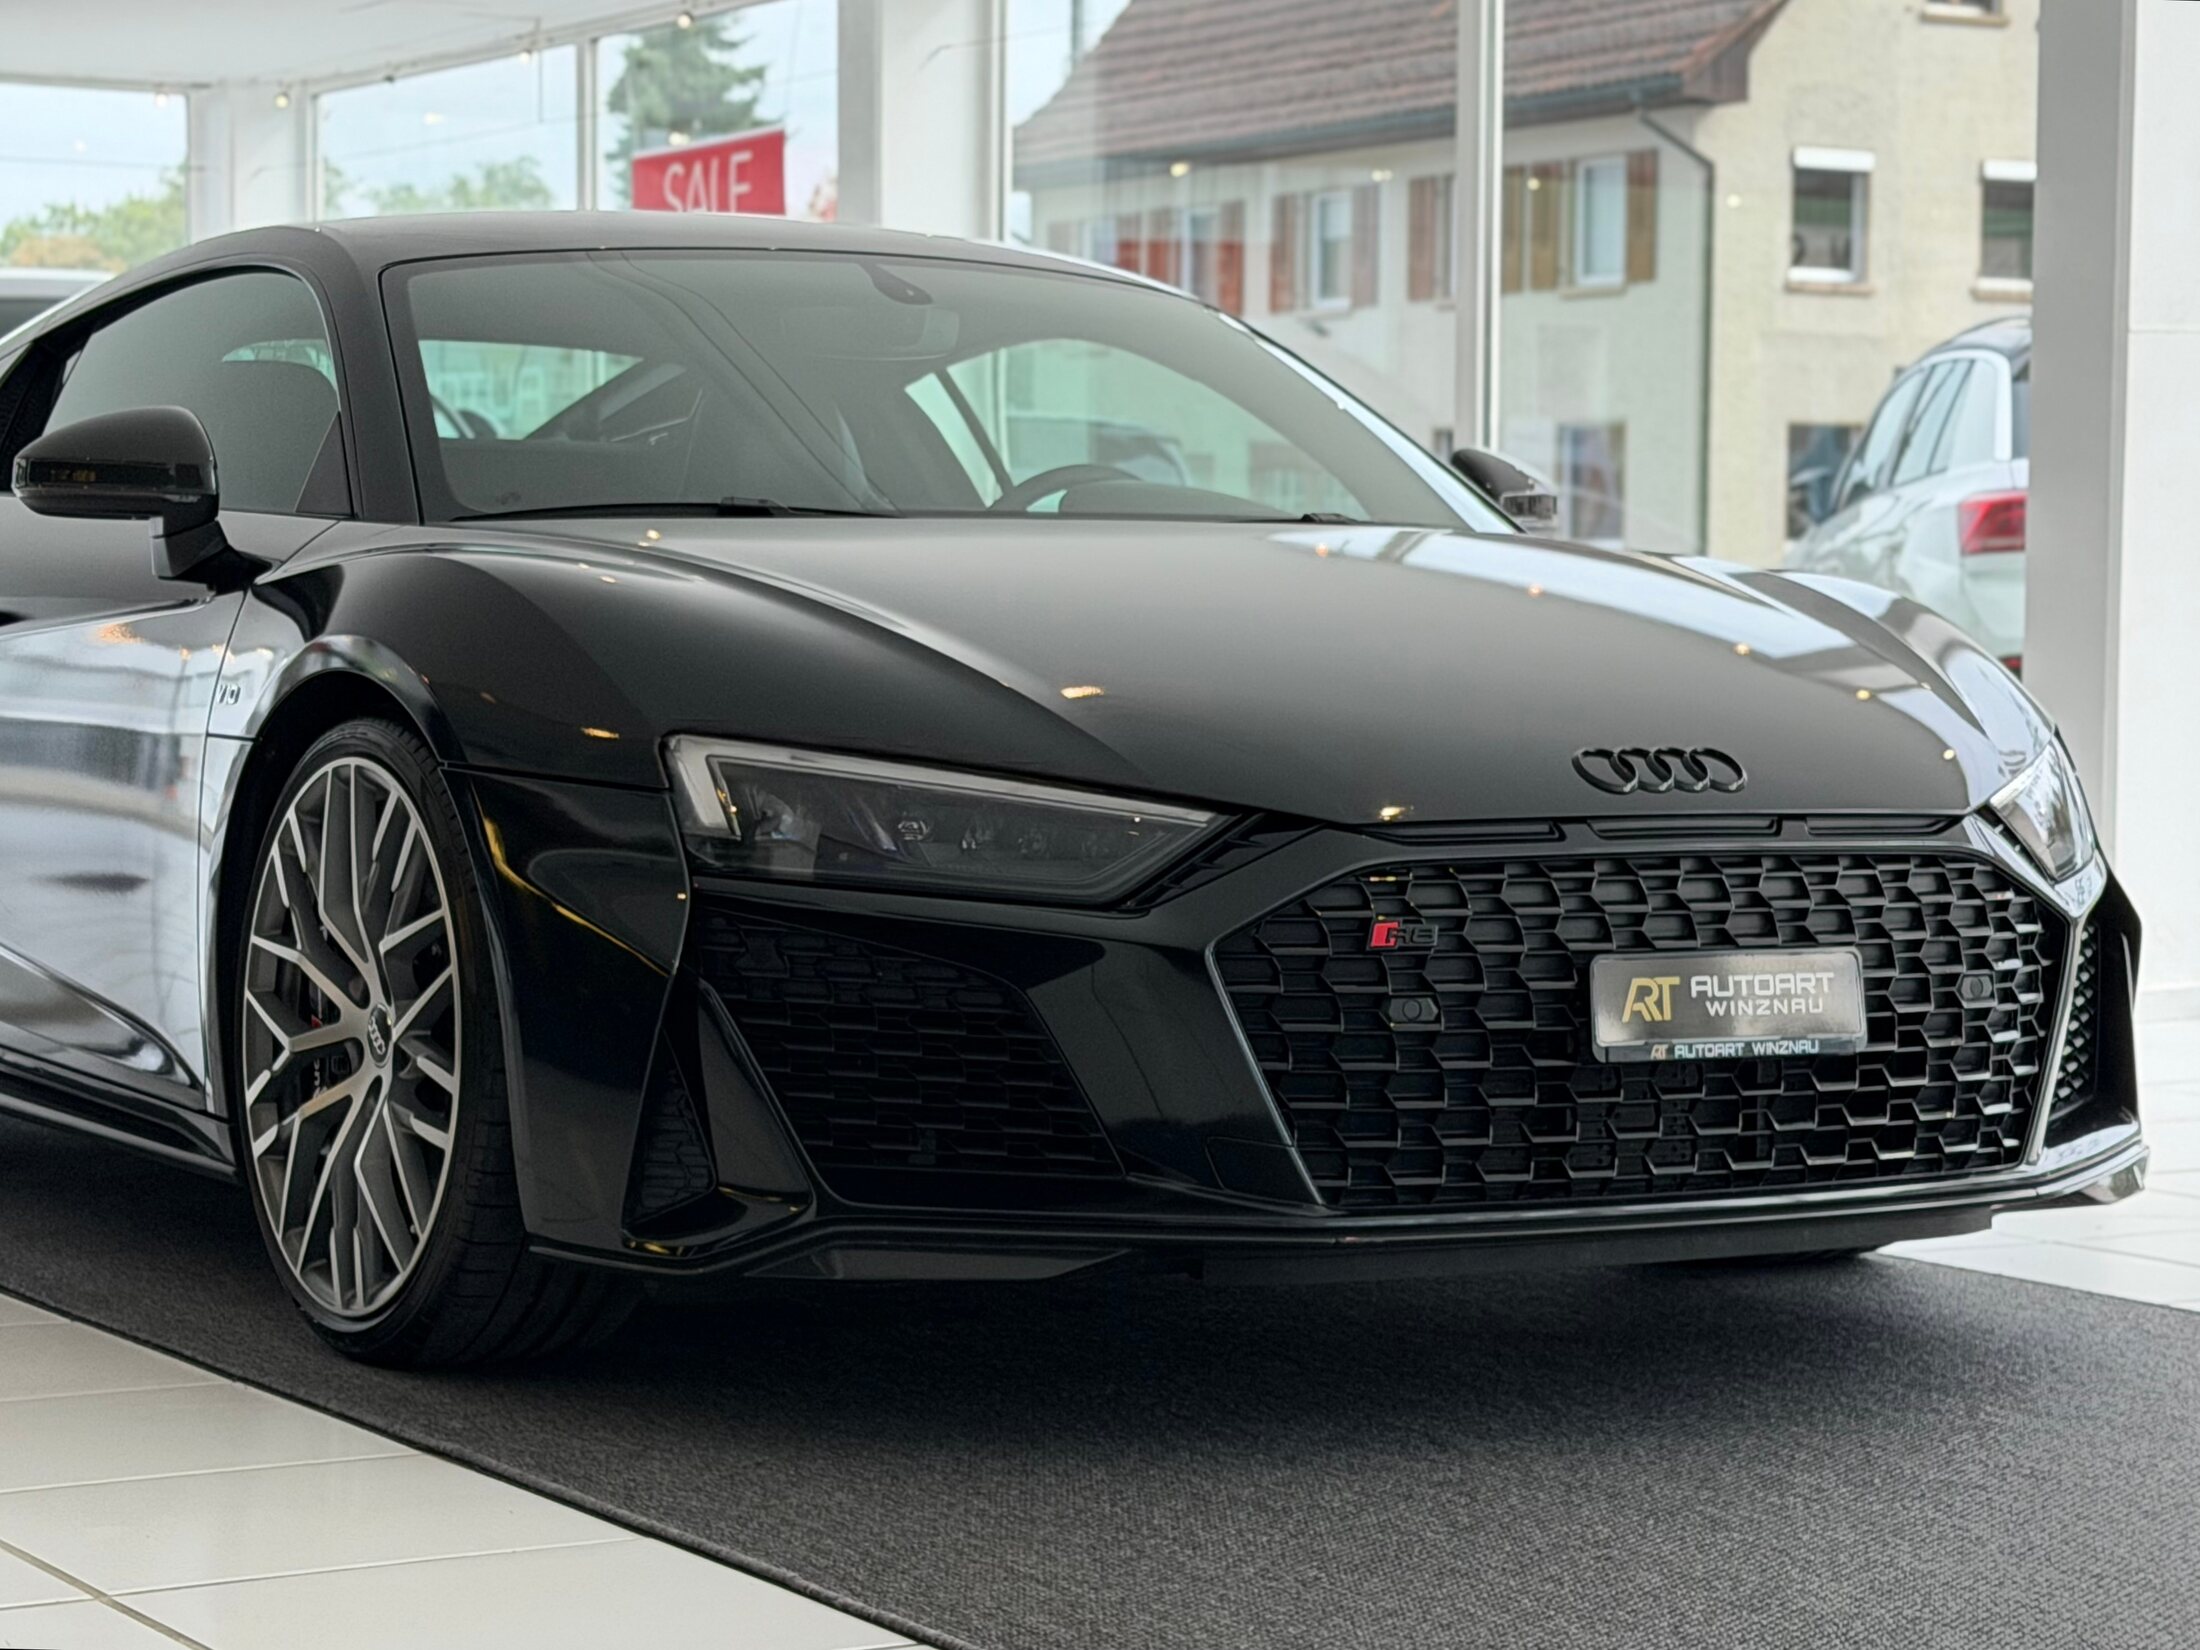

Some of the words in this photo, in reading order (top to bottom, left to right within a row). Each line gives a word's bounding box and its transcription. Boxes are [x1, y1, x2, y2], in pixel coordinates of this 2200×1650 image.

[1690, 972, 1835, 998] AUTOART
[1705, 997, 1824, 1017] WINZNAU
[1674, 1042, 1745, 1059] AUTOART
[1752, 1040, 1820, 1055] WINZNAU
